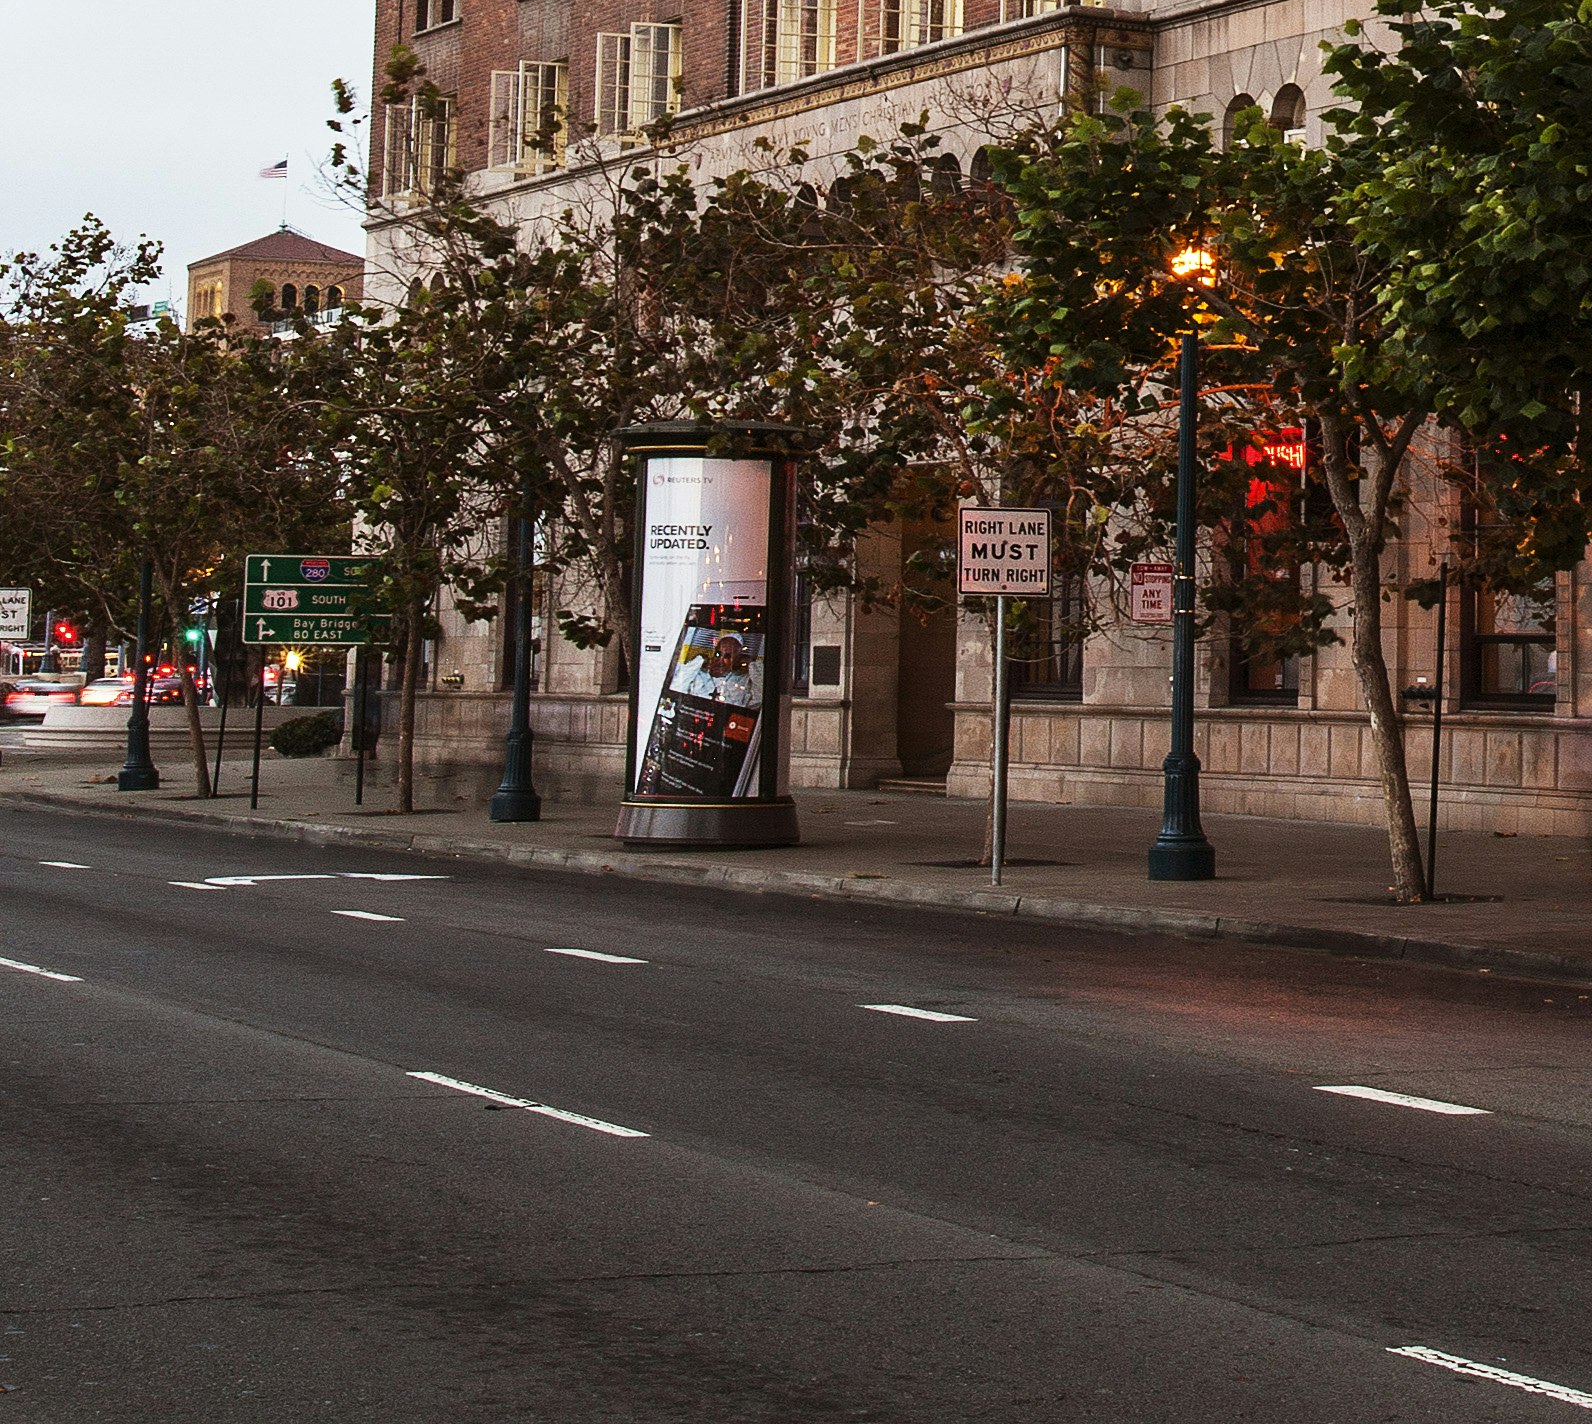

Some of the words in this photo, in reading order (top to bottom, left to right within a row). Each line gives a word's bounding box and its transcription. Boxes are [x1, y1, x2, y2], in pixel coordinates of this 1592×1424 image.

[666, 476, 701, 484] REUTERS
[650, 525, 713, 537] RECENTLY
[965, 521, 1004, 534] RIGHT
[1009, 522, 1045, 535] LANE
[650, 538, 710, 550] UPDATED.
[971, 543, 1038, 560] MUST
[305, 568, 326, 578] 280
[964, 568, 1000, 582] TURN
[1006, 569, 1046, 583] RIGHT
[1142, 589, 1161, 598] ANY
[270, 596, 292, 608] 101
[311, 595, 346, 605] SOUTH
[1142, 600, 1162, 609] TIME
[1, 610, 18, 619] ST
[293, 619, 315, 629] Bay
[320, 618, 357, 631] Bridge
[293, 630, 309, 640] 80
[314, 630, 343, 640] EAST
